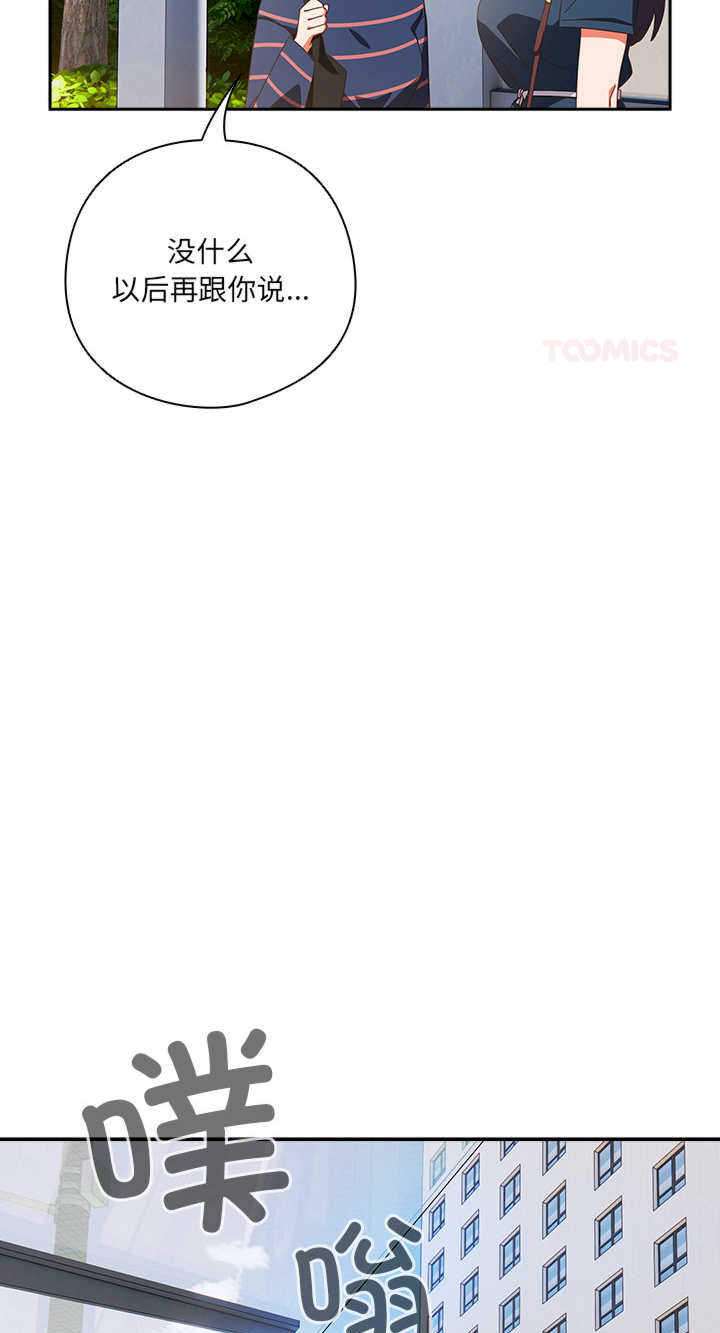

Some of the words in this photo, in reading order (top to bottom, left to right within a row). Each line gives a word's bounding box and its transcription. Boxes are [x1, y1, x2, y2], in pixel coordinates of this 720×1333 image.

[168, 237, 253, 265] 没什么
[112, 275, 309, 304] 以后再跟你说...
